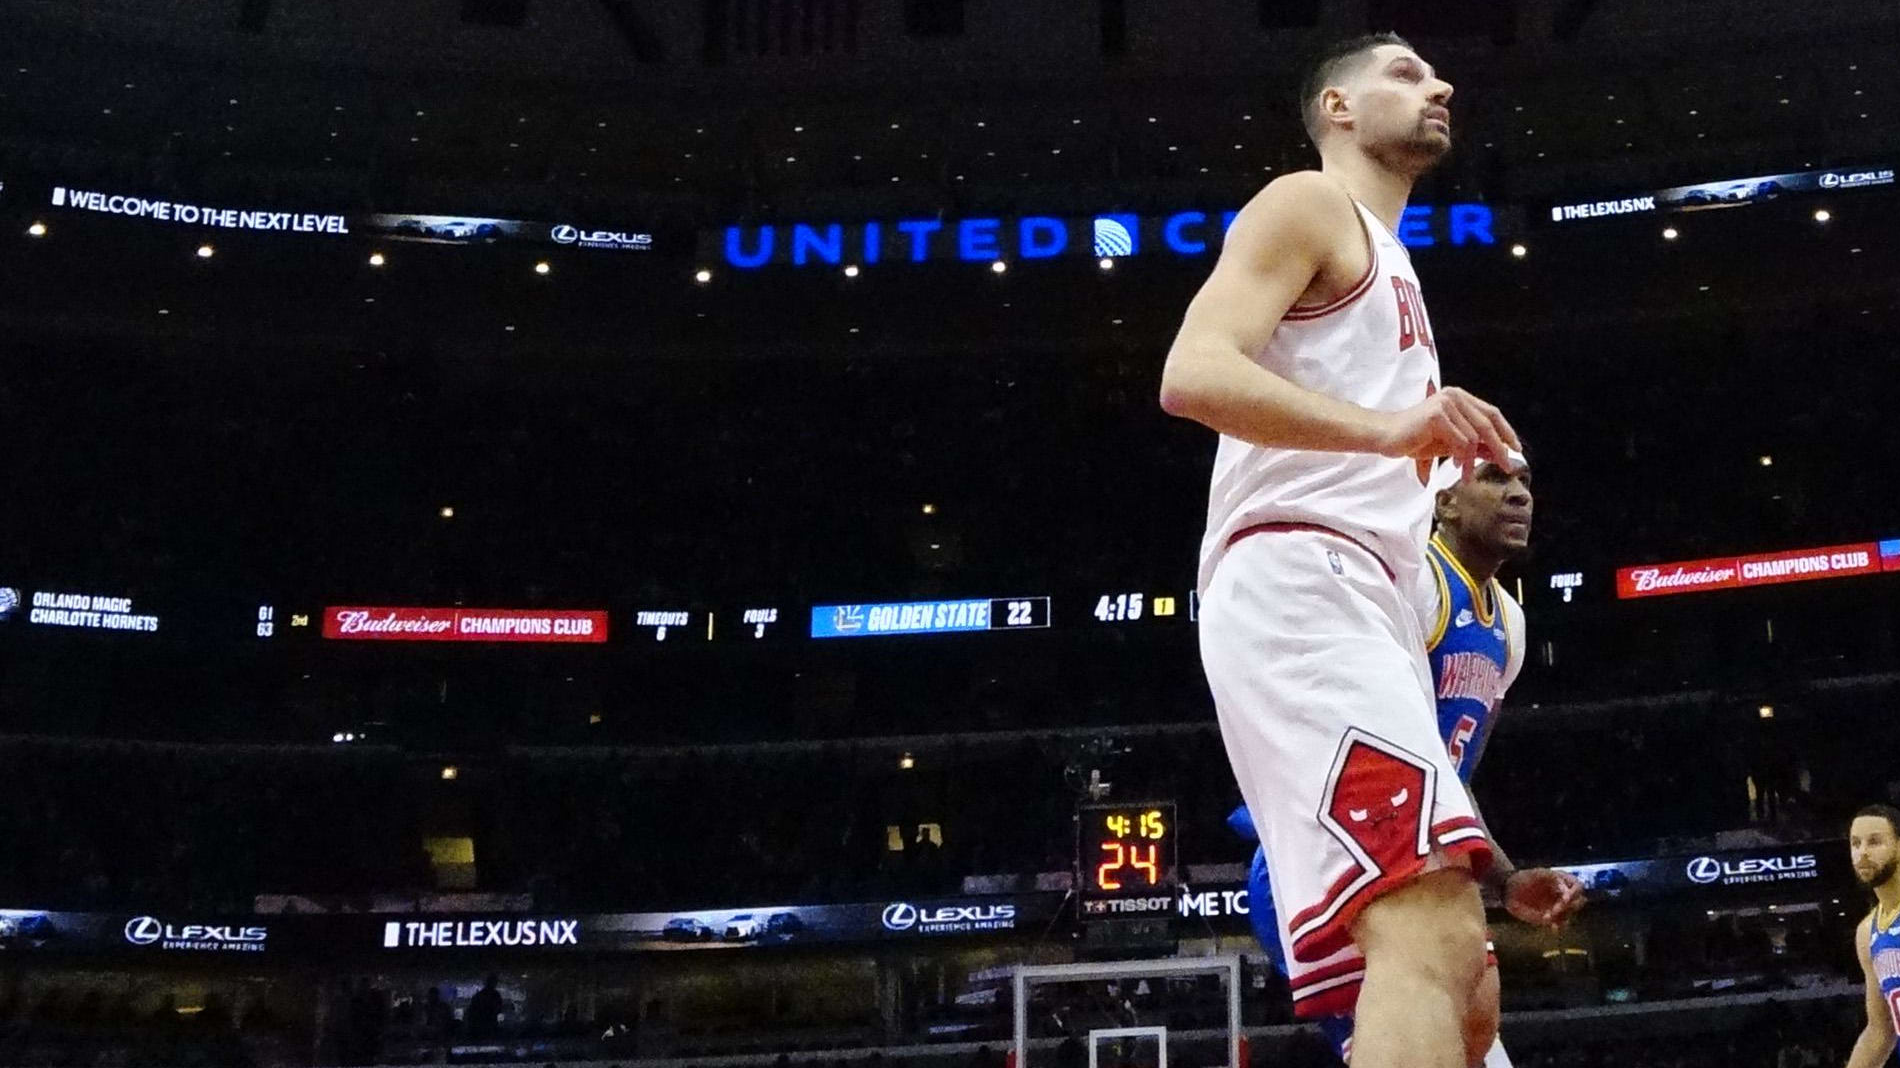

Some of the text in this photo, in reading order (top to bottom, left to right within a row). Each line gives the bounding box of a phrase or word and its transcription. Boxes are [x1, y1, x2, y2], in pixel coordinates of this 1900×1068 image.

[69, 189, 348, 234] WELCOME TO THE NEXT LEVEL
[1563, 196, 1656, 220] THE LEXUS NX
[580, 230, 652, 244] LEXUS
[724, 203, 1496, 267] UNITED CER
[1550, 573, 1583, 589] FOULS
[1631, 550, 1869, 592] Budweiser CHAMPIONS CLUB
[33, 592, 132, 613] ORLANDO MAGIC
[1094, 593, 1143, 621] 4:15
[30, 609, 158, 631] CHARLOTTE HORNETS
[336, 610, 594, 637] Budweiser CHAMPIONS CLUB
[637, 611, 689, 628] TIMEOUTS
[743, 608, 777, 624] FOULS
[868, 601, 1033, 632] GOLDEN STATE 22
[1447, 714, 1478, 778] 5
[1106, 812, 1164, 839] 4:15
[1098, 844, 1156, 890] 24
[1723, 854, 1817, 875] LEXUS
[919, 904, 1016, 923] LEXUS
[1109, 897, 1171, 914] TISSOT
[166, 924, 268, 941] LEXUS
[405, 919, 578, 947] THE LEXUS NX
